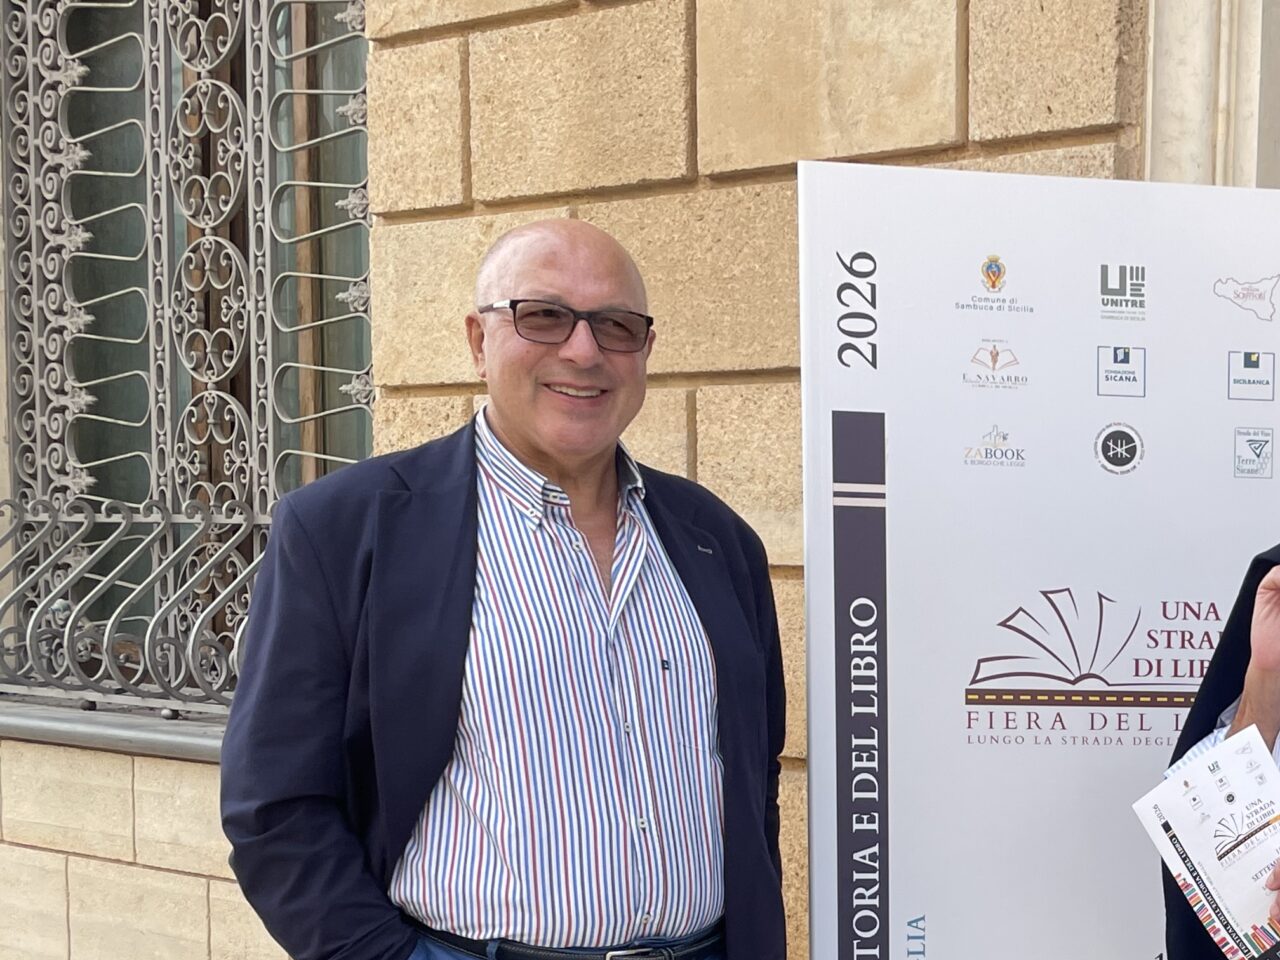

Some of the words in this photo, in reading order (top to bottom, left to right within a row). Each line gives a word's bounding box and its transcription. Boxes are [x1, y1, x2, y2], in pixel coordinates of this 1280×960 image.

[955, 303, 994, 311] Sambuca
[1008, 305, 1034, 313] Sicilia
[971, 296, 1006, 304] Comune
[1101, 298, 1145, 308] UNITRE
[836, 251, 877, 370] 2026
[964, 447, 1026, 461] ZABOOK
[1161, 601, 1221, 621] UNA
[1147, 629, 1223, 650] STRA
[849, 597, 878, 718] LIBRO
[1133, 658, 1163, 677] DI
[966, 711, 1067, 730] FIERA
[1089, 712, 1152, 731] DEL
[967, 735, 1025, 744] LUNGO
[1034, 735, 1051, 745] LA
[1061, 736, 1124, 746] STRADA
[1132, 737, 1173, 746] DEGL
[851, 726, 879, 802] DEL
[1245, 797, 1263, 812] UNA
[1245, 798, 1275, 821] STRADA
[852, 812, 879, 834] E
[1246, 820, 1256, 830] DI
[1255, 807, 1276, 824] LIBRI
[1170, 837, 1187, 858] LIBRO
[1183, 857, 1195, 872] DEL
[1225, 923, 1249, 955] FESTIVAL
